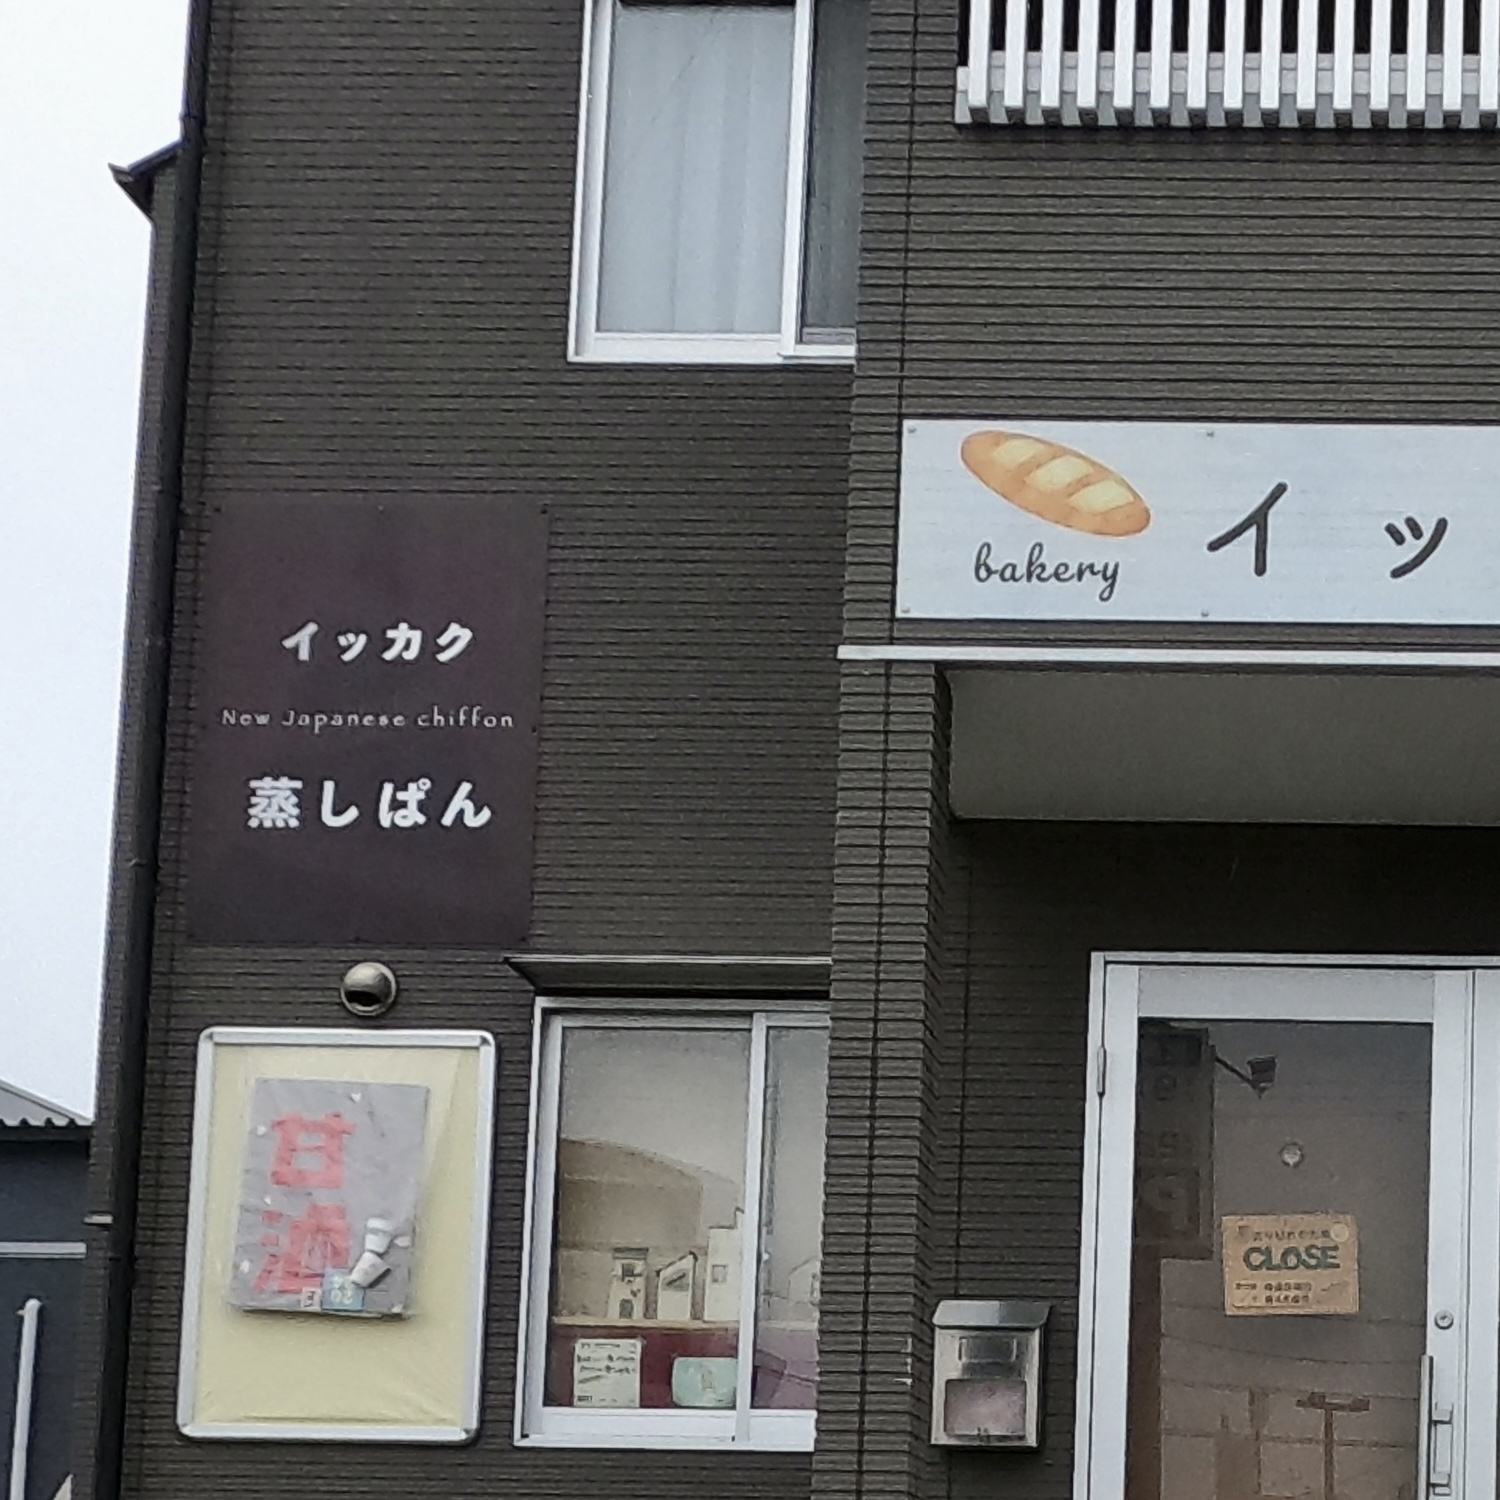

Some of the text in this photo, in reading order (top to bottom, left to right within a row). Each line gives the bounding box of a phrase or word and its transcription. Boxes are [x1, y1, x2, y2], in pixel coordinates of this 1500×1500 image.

[973, 541, 1120, 602] bakery
[280, 621, 475, 663] イッカク
[221, 705, 515, 734] New Japanese chiffon
[246, 776, 493, 829] 蒸しぱん
[1242, 1244, 1341, 1272] CLOSE
